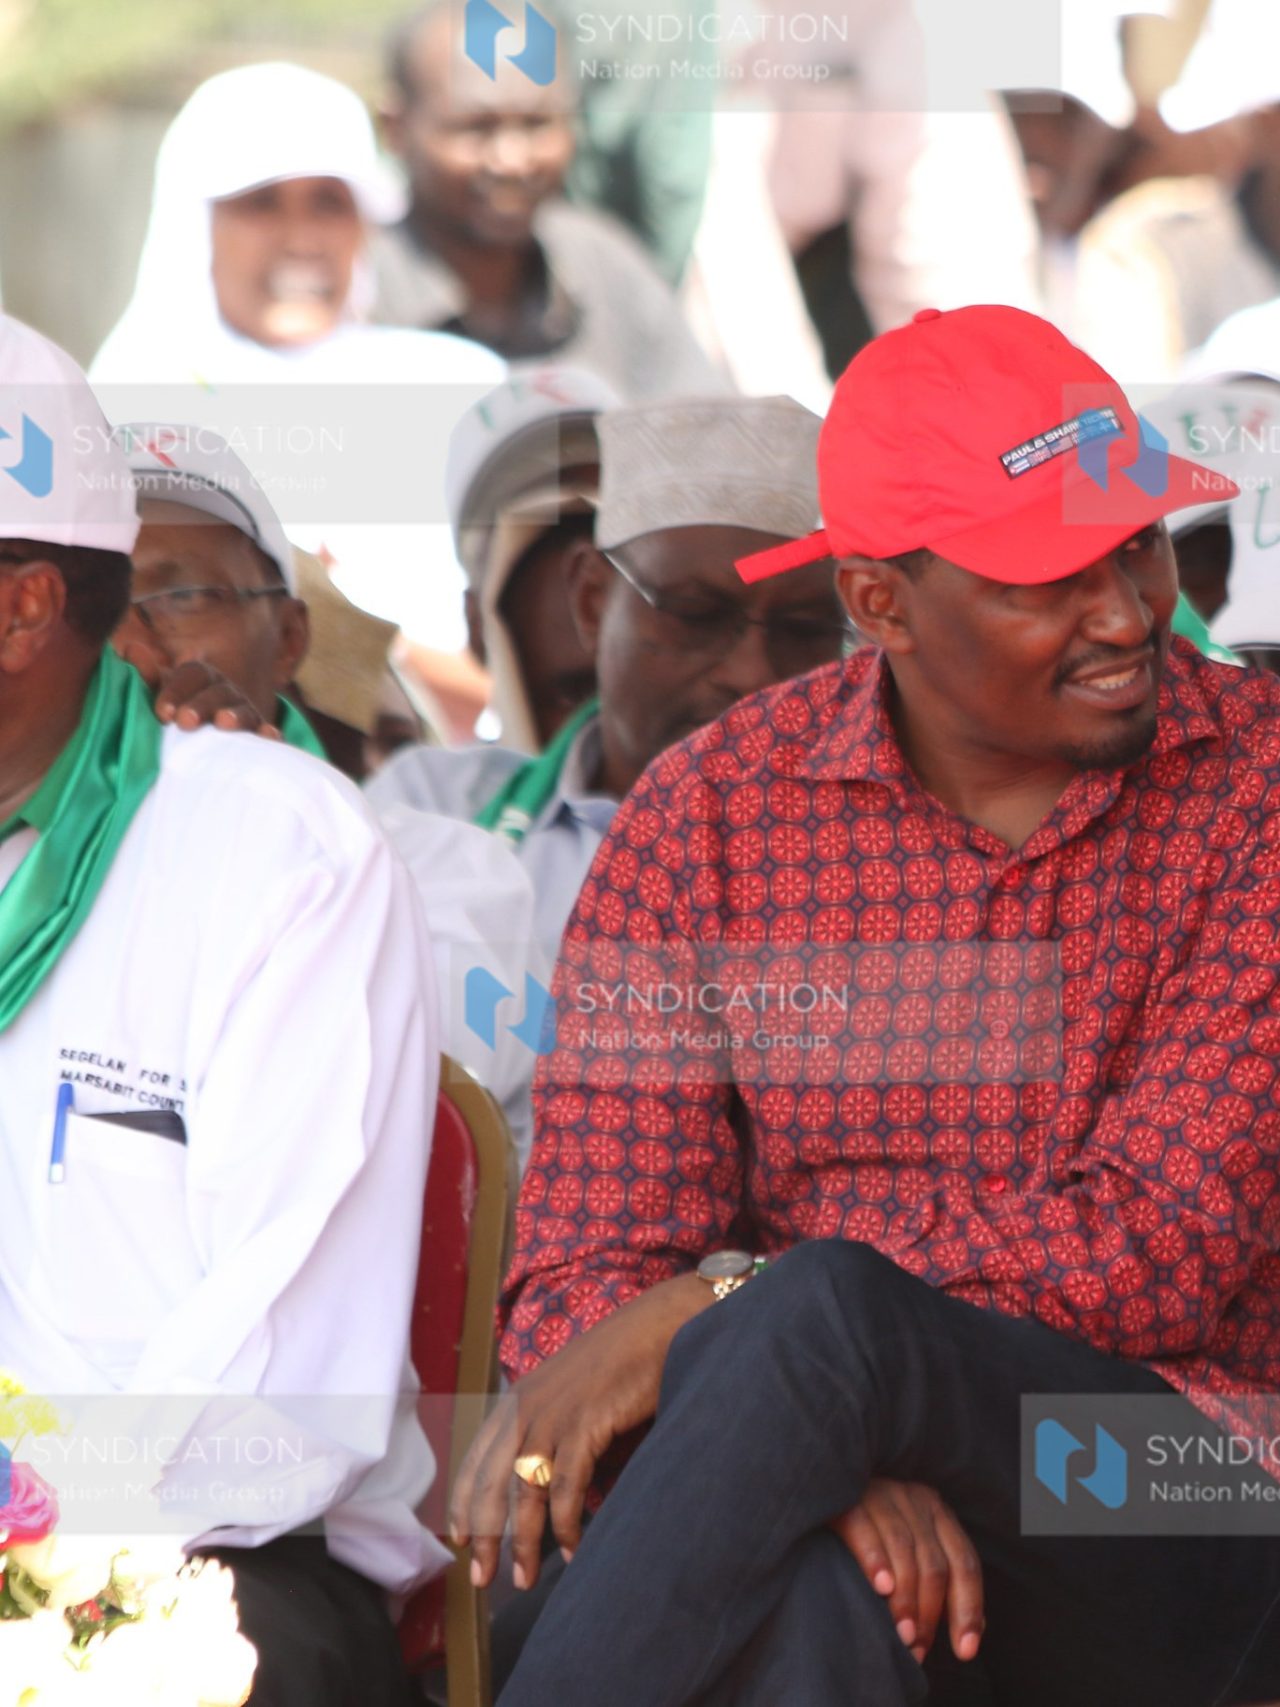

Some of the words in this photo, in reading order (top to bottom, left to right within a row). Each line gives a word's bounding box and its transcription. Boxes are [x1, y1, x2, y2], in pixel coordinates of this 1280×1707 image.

[1001, 443, 1035, 466] PAUL
[1034, 436, 1046, 450] &
[60, 1069, 134, 1098] MARSABIT
[138, 1091, 185, 1112] COUNT
[139, 1069, 170, 1086] FOR
